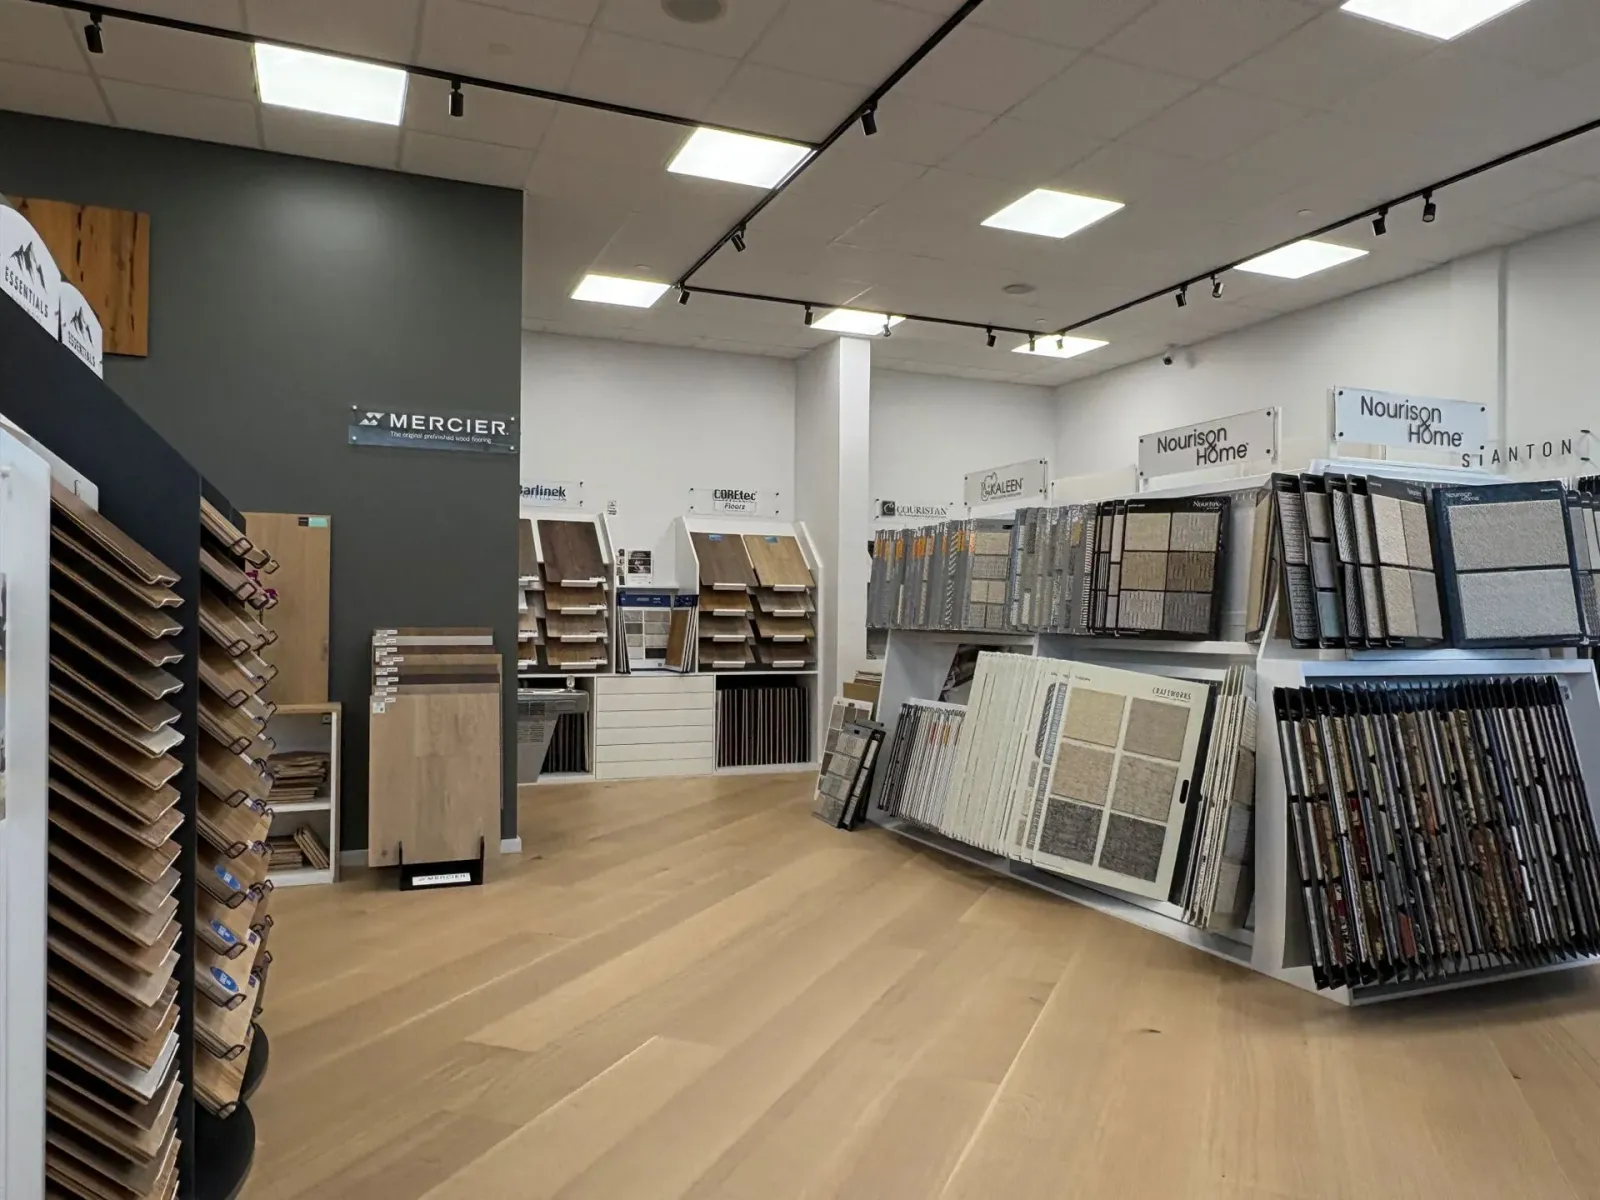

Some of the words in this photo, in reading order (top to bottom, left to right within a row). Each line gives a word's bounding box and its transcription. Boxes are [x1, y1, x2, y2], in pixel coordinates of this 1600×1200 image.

[5, 266, 49, 318] ESSENTIALS
[1361, 395, 1442, 424] Nourison
[390, 413, 507, 436] MERCIER
[1408, 423, 1463, 448] Home
[1157, 427, 1227, 454] Nourison
[1196, 443, 1248, 466] Home
[714, 489, 756, 501] COREtec
[991, 477, 1023, 496] KALEEN
